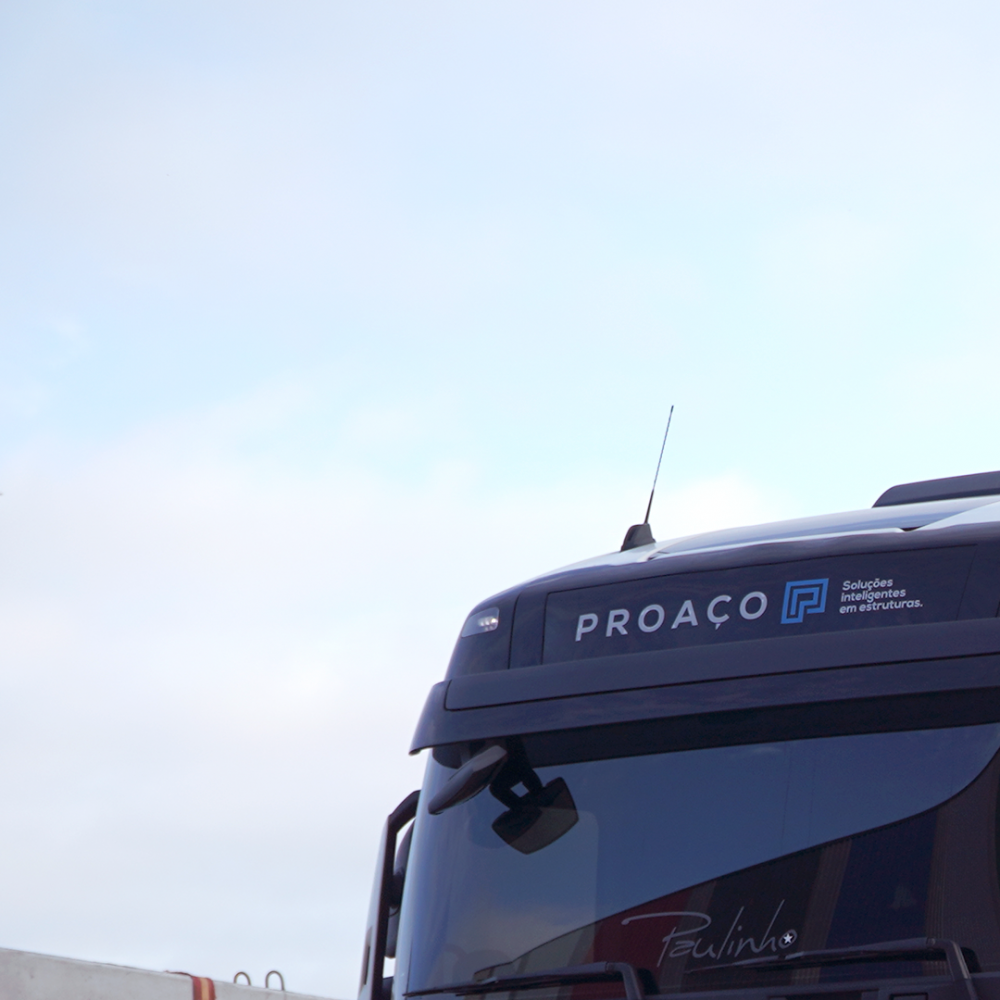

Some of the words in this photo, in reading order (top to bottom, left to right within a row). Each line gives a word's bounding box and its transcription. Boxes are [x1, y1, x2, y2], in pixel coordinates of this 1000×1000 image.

[842, 578, 893, 591] Soluções
[840, 589, 906, 603] inteligentes
[839, 605, 857, 614] em
[858, 600, 923, 612] estruturas.
[575, 591, 768, 642] PROAÇO
[621, 899, 798, 967] Paulinho
